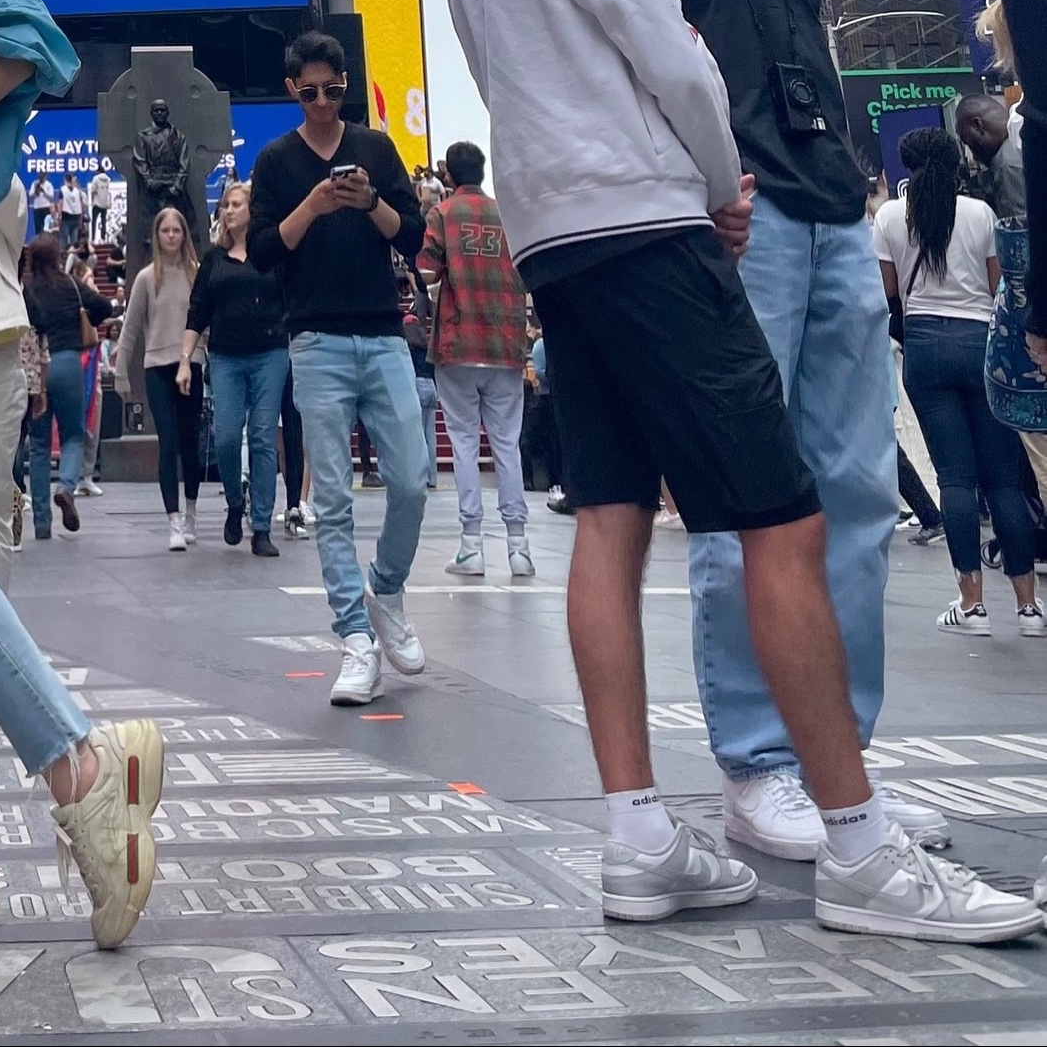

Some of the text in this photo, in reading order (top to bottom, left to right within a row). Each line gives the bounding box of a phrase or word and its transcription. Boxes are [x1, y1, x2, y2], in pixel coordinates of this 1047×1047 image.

[881, 82, 956, 100] Pick me
[45, 139, 86, 155] PLAY
[27, 159, 64, 173] FREE
[67, 158, 99, 172] BUS
[461, 222, 502, 258] 23
[255, 813, 553, 838] MUSIC
[180, 881, 536, 916] SHUBERT
[317, 924, 934, 974] HAYES
[177, 974, 314, 1022] ST
[342, 954, 1029, 1018] HELEN
